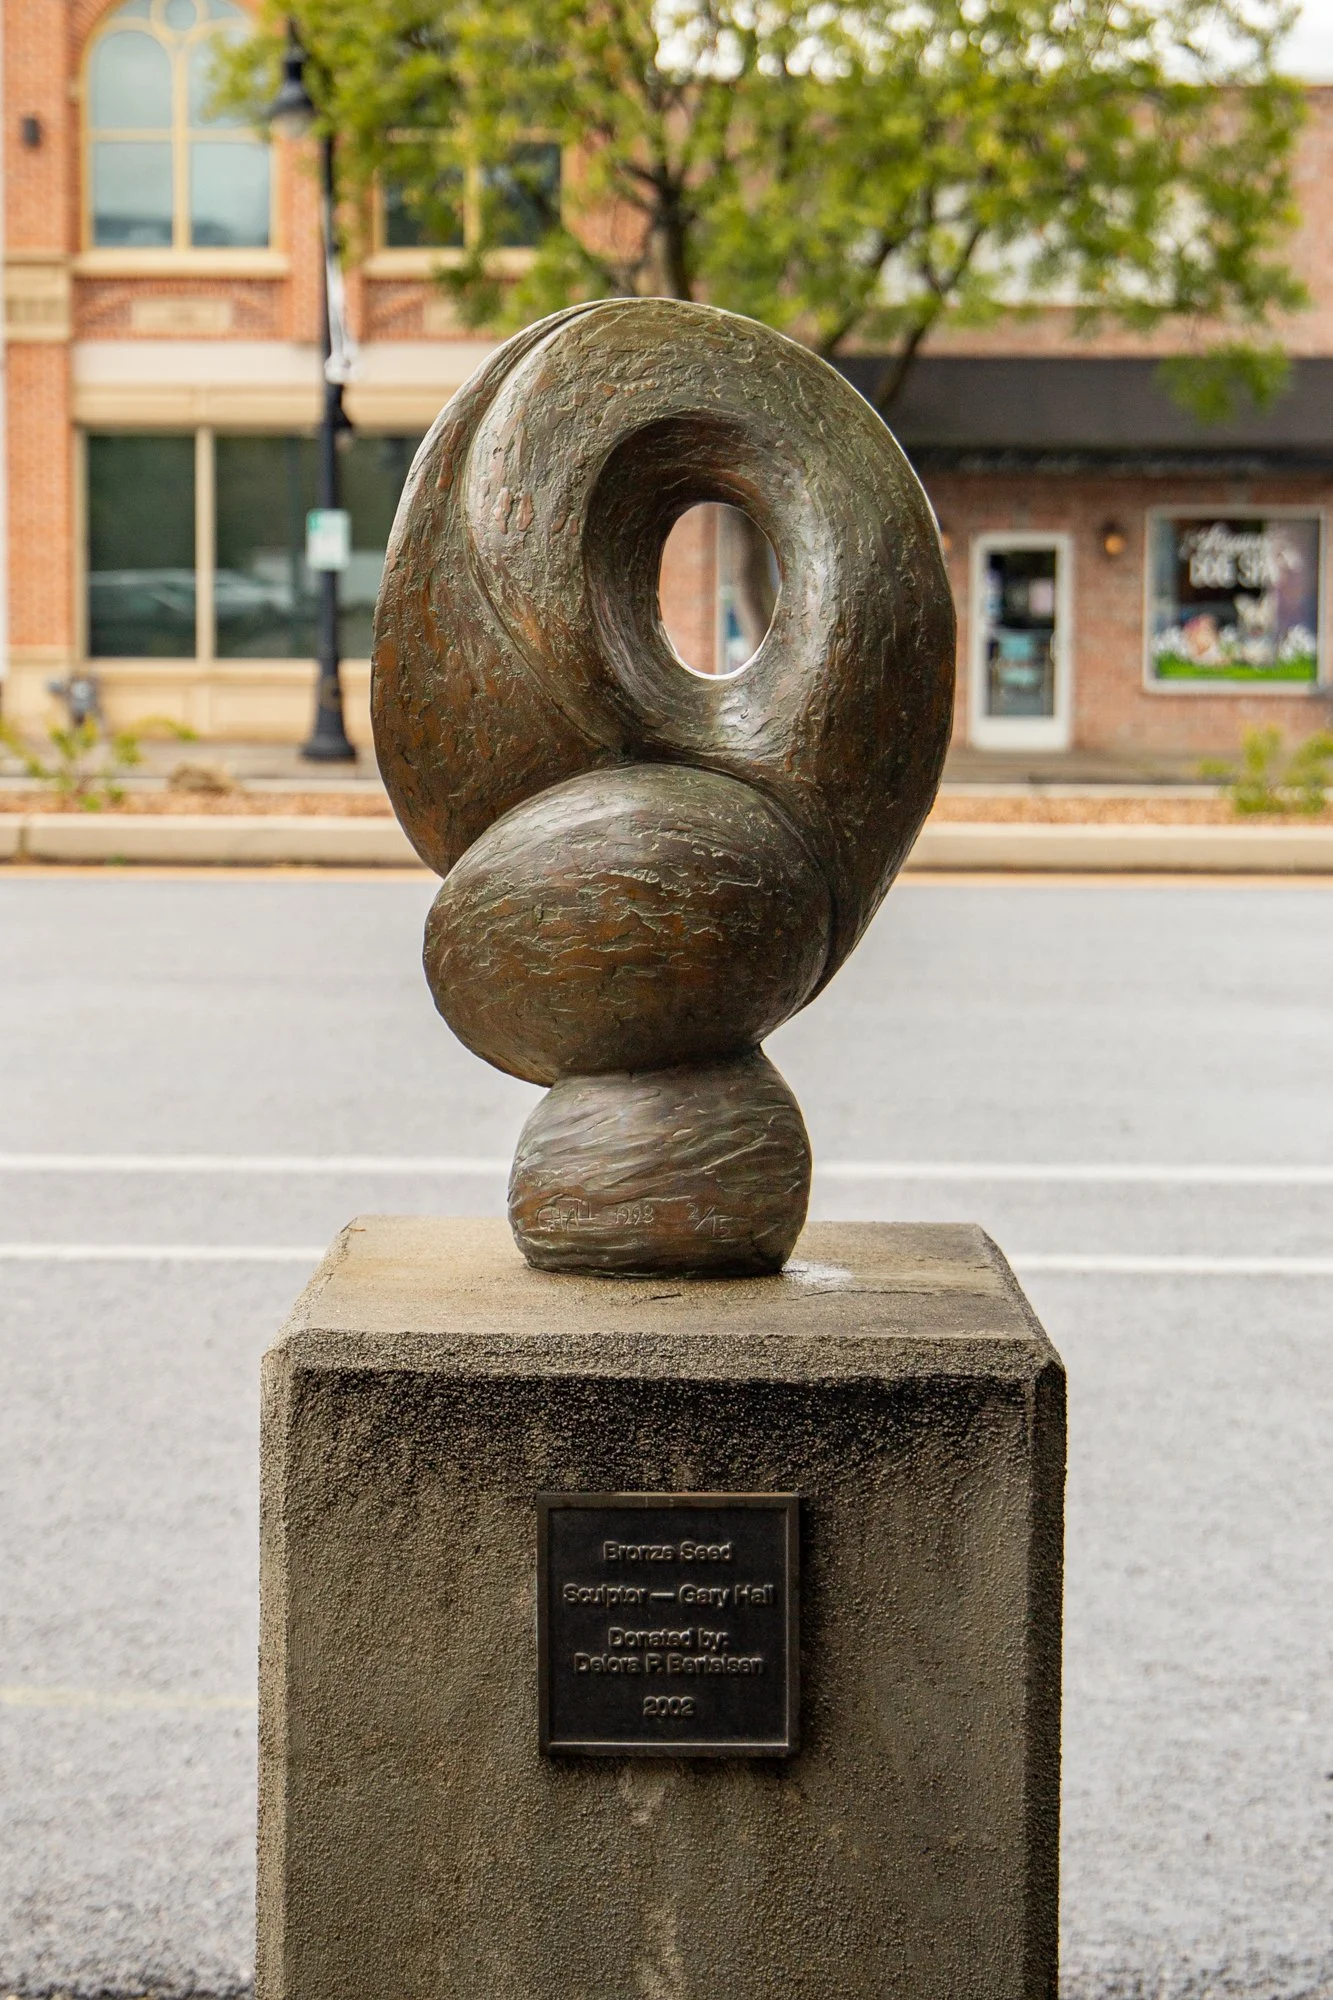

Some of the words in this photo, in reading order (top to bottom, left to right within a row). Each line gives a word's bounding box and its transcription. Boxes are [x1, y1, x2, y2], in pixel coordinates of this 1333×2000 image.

[603, 1541, 676, 1561] Bronze
[680, 1541, 733, 1561] Seed
[563, 1583, 648, 1608] Sculptor
[679, 1584, 730, 1608] Gary
[734, 1584, 774, 1605] Hall
[608, 1627, 694, 1647] Donated
[574, 1653, 641, 1673] Delora
[645, 1653, 664, 1674] P.
[667, 1653, 764, 1674] Bertelsen
[643, 1696, 695, 1717] 2002
